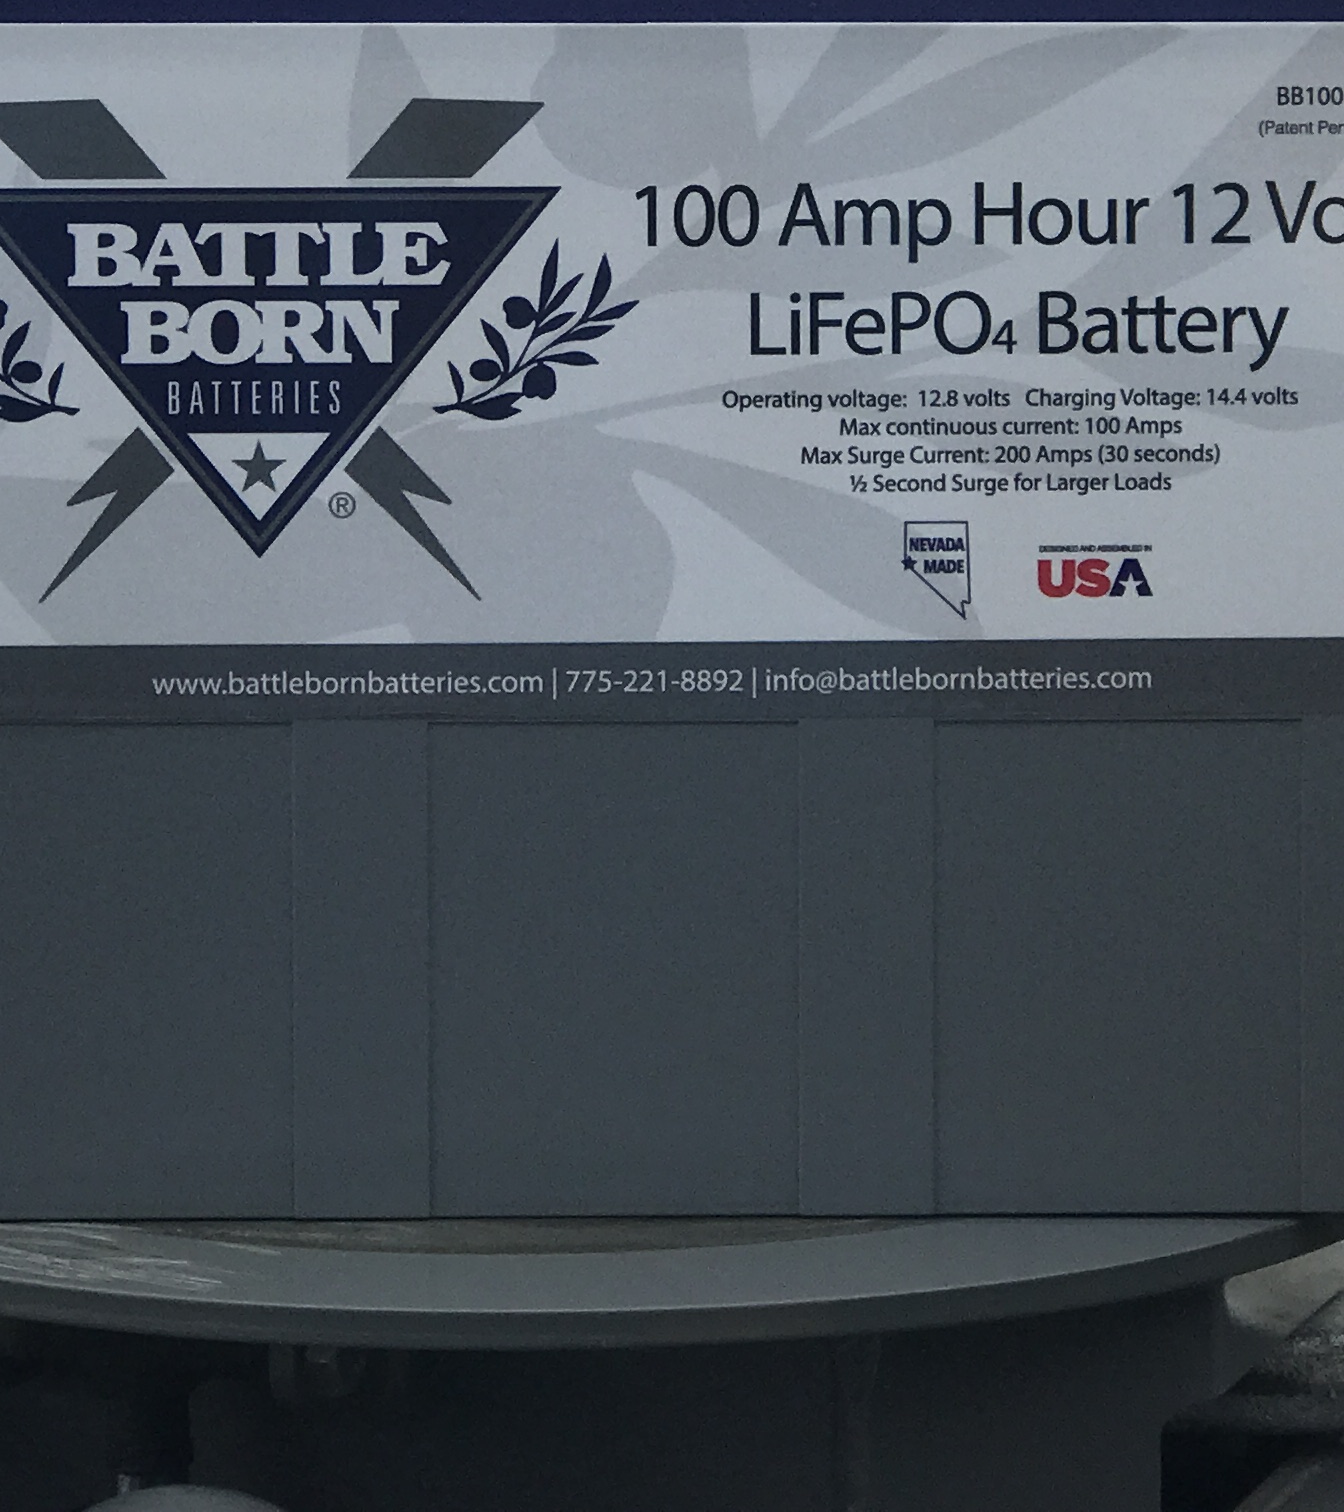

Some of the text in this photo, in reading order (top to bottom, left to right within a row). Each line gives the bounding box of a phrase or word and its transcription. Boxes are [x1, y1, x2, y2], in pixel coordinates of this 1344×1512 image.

[1258, 119, 1315, 138] (Patent
[634, 184, 761, 248] 100
[778, 181, 953, 264] Amp
[973, 180, 1151, 247] Hour
[1172, 181, 1252, 245] 12
[65, 220, 452, 288] BATTLE
[120, 299, 401, 366] BORN
[1038, 290, 1291, 373] Battery
[167, 379, 342, 416] BATTERIES
[721, 386, 1300, 413] Operating voltage: 12.8 volts Charging Voltage: 14.4 volts
[839, 416, 1184, 439] Max continuous current: 100 Amps
[801, 443, 1222, 469] Max Surge Current: 200 Amps (30 seconds)
[873, 473, 946, 493] Second
[951, 473, 1009, 497] Surge
[1013, 473, 1043, 492] for
[1046, 472, 1110, 496] Larger
[1114, 472, 1173, 491] Loads
[909, 537, 966, 552] NEVADA
[923, 559, 965, 574] MADE
[1037, 558, 1154, 598] USA
[152, 670, 544, 695] www.battlebornbatteries.com
[565, 669, 745, 693] 775-221-8892
[766, 666, 1153, 695] info@battlebornbatteries.com
